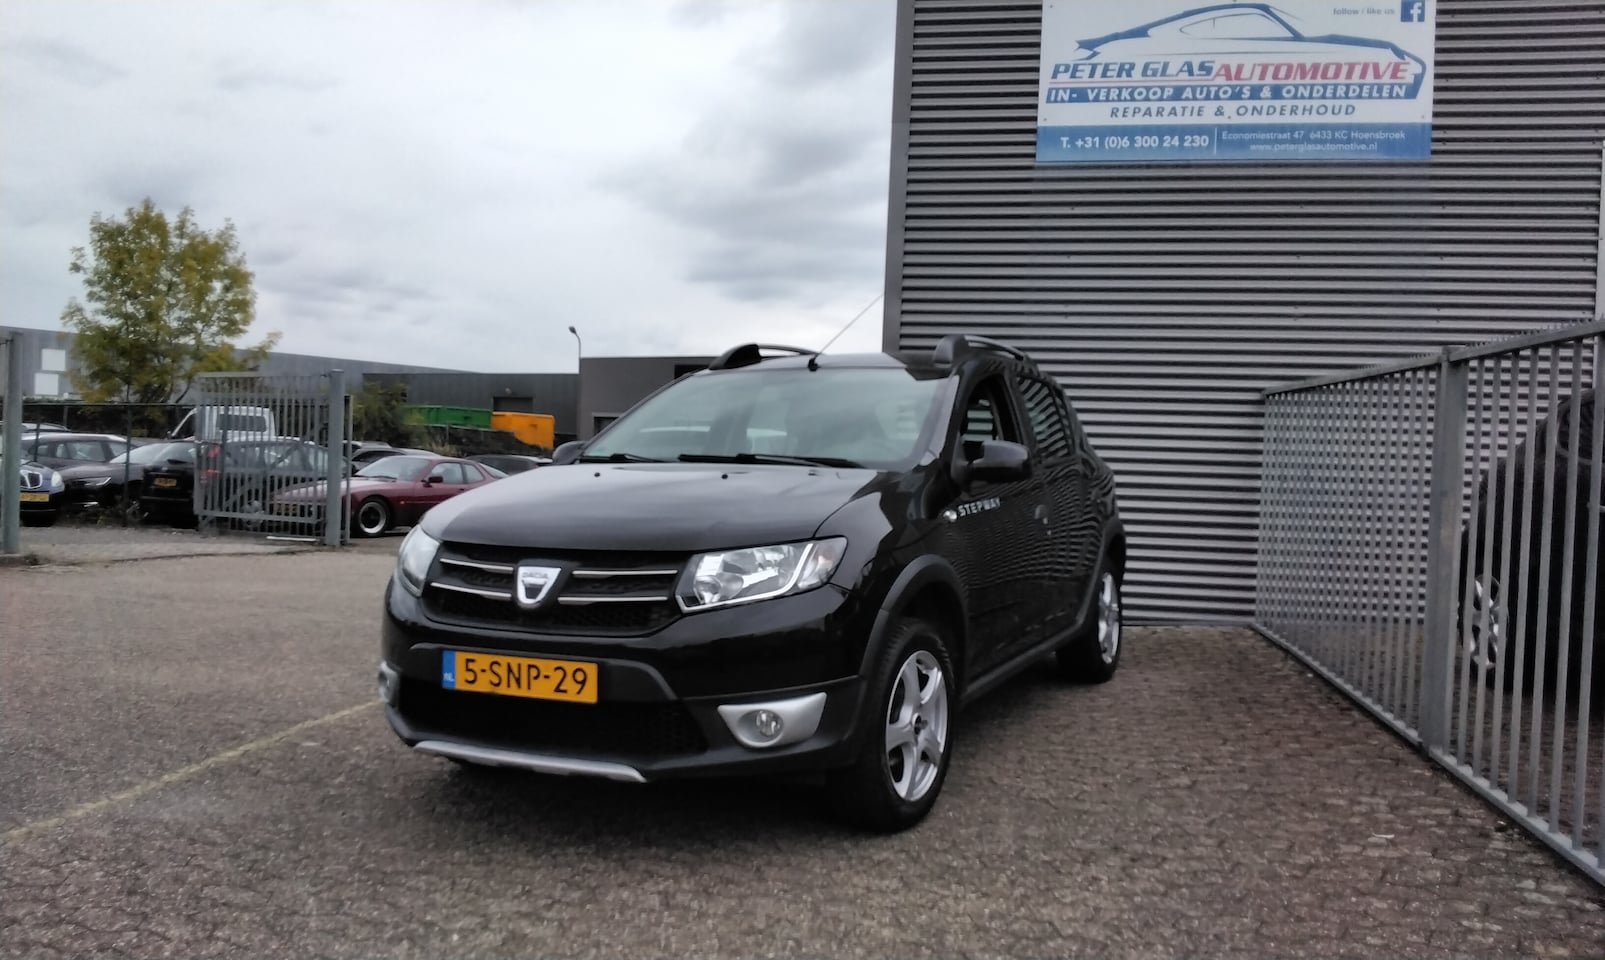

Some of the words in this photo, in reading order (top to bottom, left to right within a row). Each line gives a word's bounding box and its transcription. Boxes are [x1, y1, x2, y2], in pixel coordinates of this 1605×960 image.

[1051, 61, 1136, 80] PETER
[1050, 87, 1078, 101] IN-
[1087, 87, 1174, 101] VERKOOP
[1181, 85, 1251, 100] AUTO'S
[1260, 86, 1272, 98] &
[1282, 84, 1407, 99] ONDERDELEN
[1110, 105, 1205, 118] REPARATIE
[1214, 105, 1225, 116] &
[1236, 104, 1356, 116] ONDERHOUD
[1060, 137, 1071, 148] T.
[1075, 136, 1100, 148] +31
[1104, 136, 1130, 149] (0)6
[1134, 135, 1159, 148] 300
[1162, 135, 1180, 147] 24
[1183, 135, 1209, 147] 230
[1222, 131, 1291, 140] Economiestraat
[1293, 130, 1304, 140] 47
[1309, 131, 1332, 140] 6433
[1334, 130, 1348, 139] KC
[1351, 130, 1406, 139] Hoensbroek
[1250, 142, 1378, 152] www.peterglasautomotive.nl
[464, 658, 588, 695] 5-SNP-29
